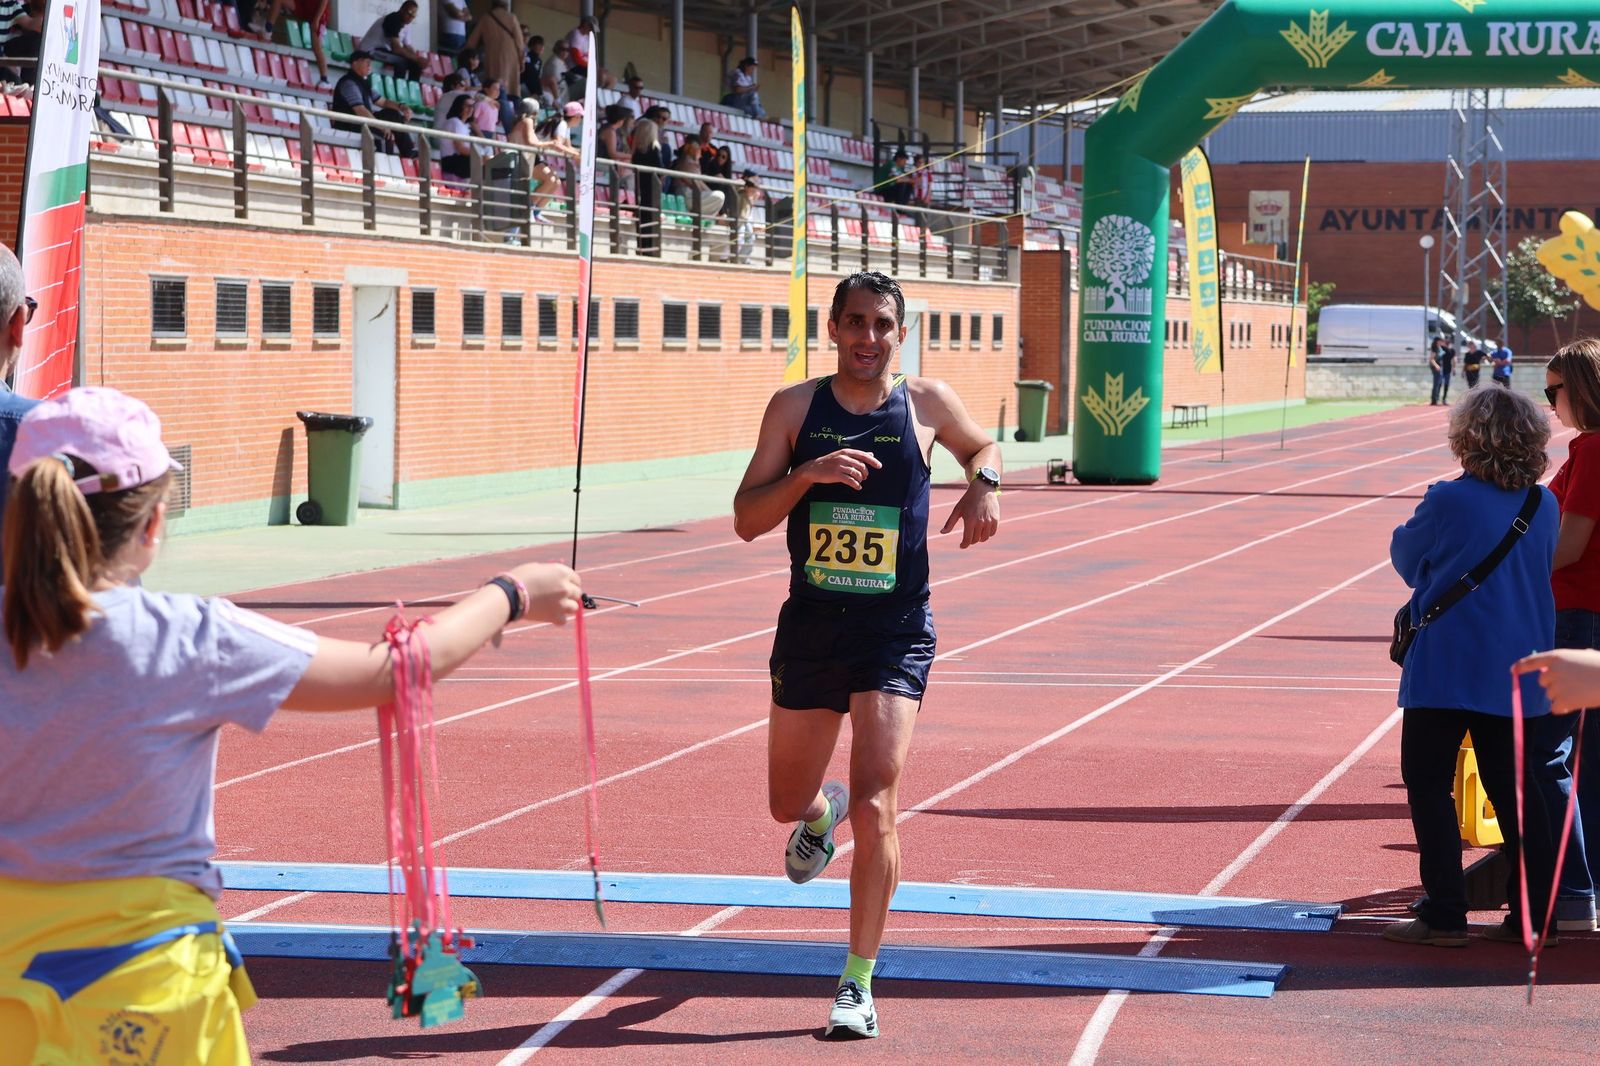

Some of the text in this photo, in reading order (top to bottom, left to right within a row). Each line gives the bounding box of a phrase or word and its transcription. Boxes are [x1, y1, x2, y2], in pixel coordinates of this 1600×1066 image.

[1366, 22, 1472, 58] CAJA
[1084, 320, 1151, 331] FUNDACION
[1083, 331, 1151, 343] CAJA RURAL
[832, 512, 875, 522] CAJA RURAL
[814, 528, 884, 567] 235
[827, 575, 891, 590] CAJA RURAL
